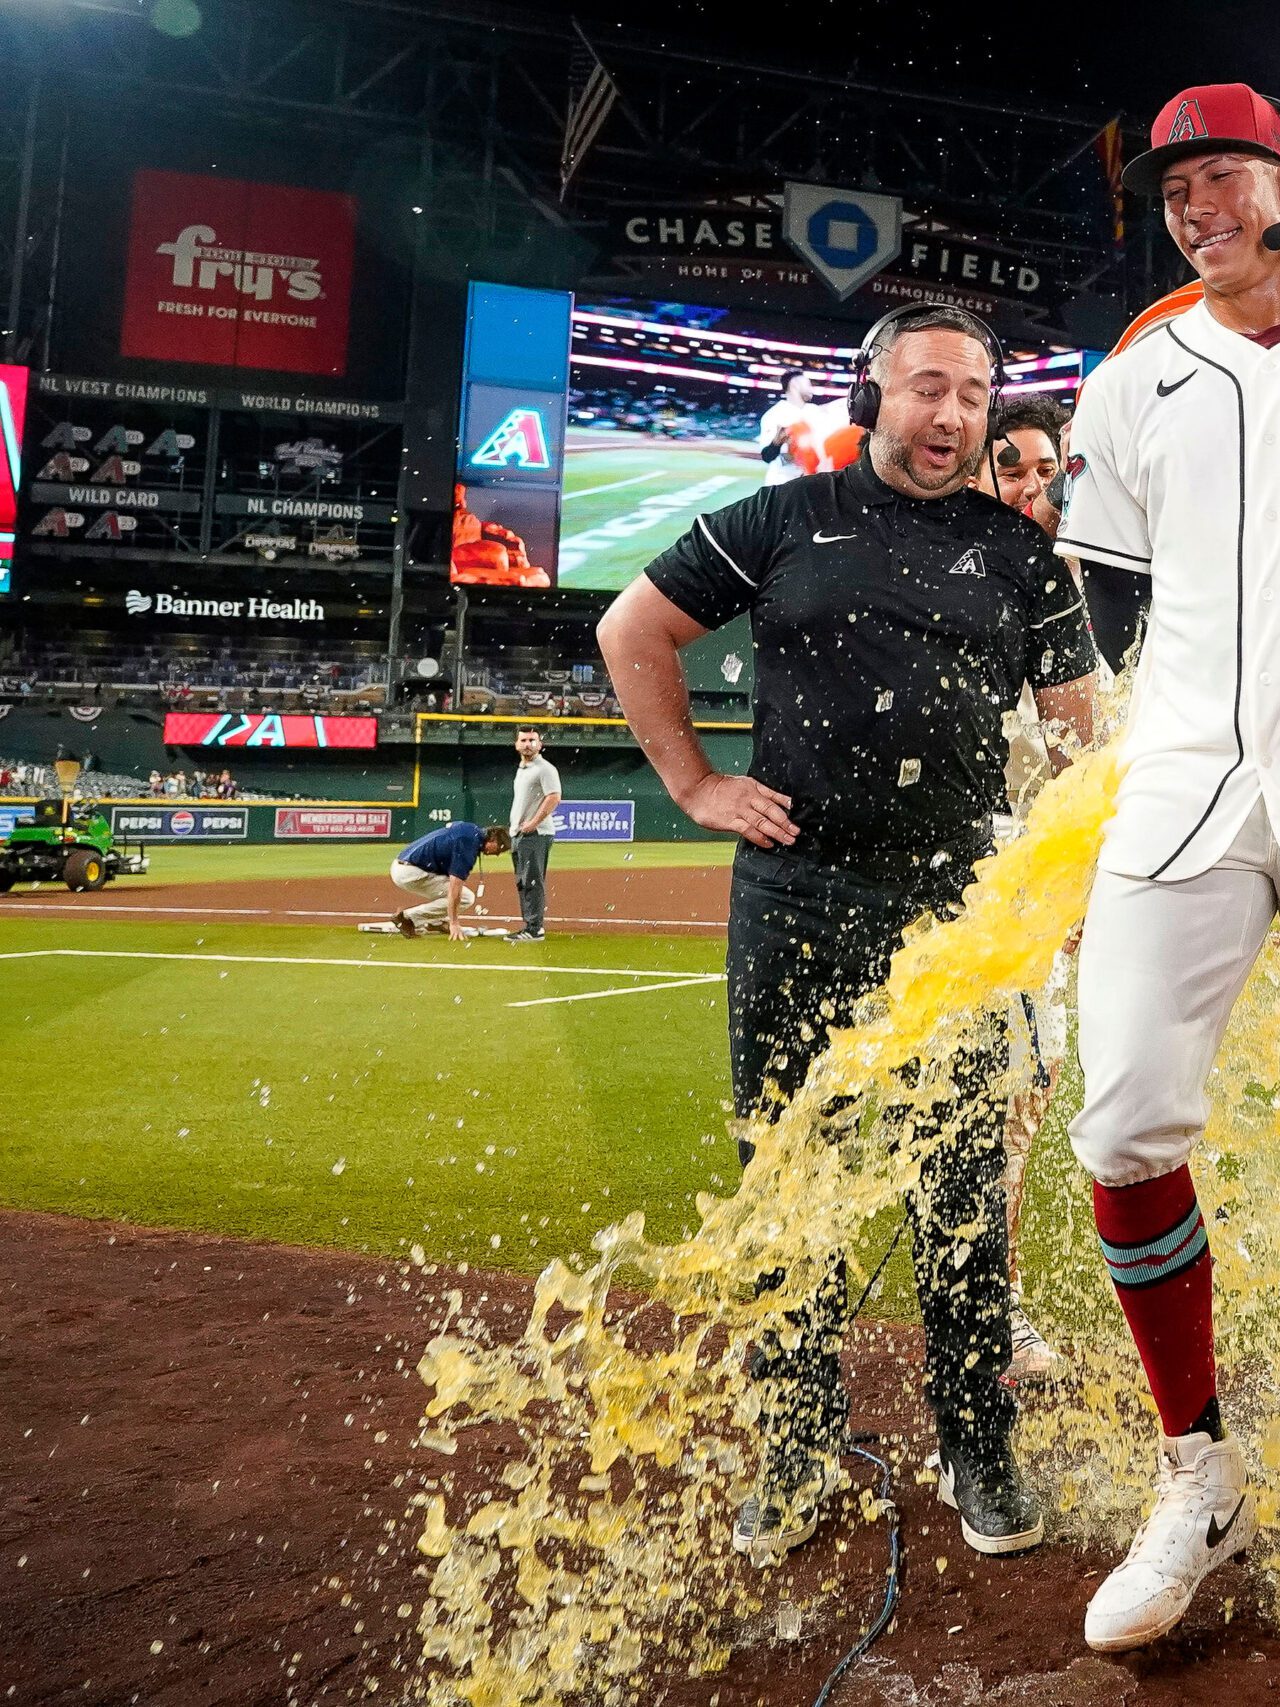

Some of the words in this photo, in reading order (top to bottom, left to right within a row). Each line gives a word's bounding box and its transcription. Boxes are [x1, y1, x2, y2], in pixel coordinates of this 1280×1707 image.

[625, 217, 773, 248] CHASE
[156, 224, 324, 301] fry's
[912, 243, 1040, 292] FIELD
[678, 265, 729, 278] HOME
[741, 268, 764, 280] OF
[777, 271, 810, 284] THE
[872, 282, 993, 314] DIAMONDBACKS
[158, 301, 202, 316] FRESH
[208, 306, 238, 319] FOR
[243, 309, 318, 328] EVERYONE
[39, 377, 60, 392] NL
[65, 379, 111, 396] WEST
[115, 383, 207, 404] CHAMPIONS
[241, 394, 291, 411] WORLD
[295, 399, 380, 419] CHAMPIONS
[68, 488, 111, 504] WILD
[115, 491, 159, 507] CARD
[247, 499, 268, 514] NL
[272, 500, 364, 520] CHAMPIONS
[155, 593, 245, 617] Banner
[247, 597, 325, 621] Health
[119, 816, 162, 830] PEPSI
[202, 816, 242, 829] PEPSI
[429, 809, 452, 821] 413
[569, 811, 619, 822] ENERGY
[569, 820, 629, 831] TRANSFER
